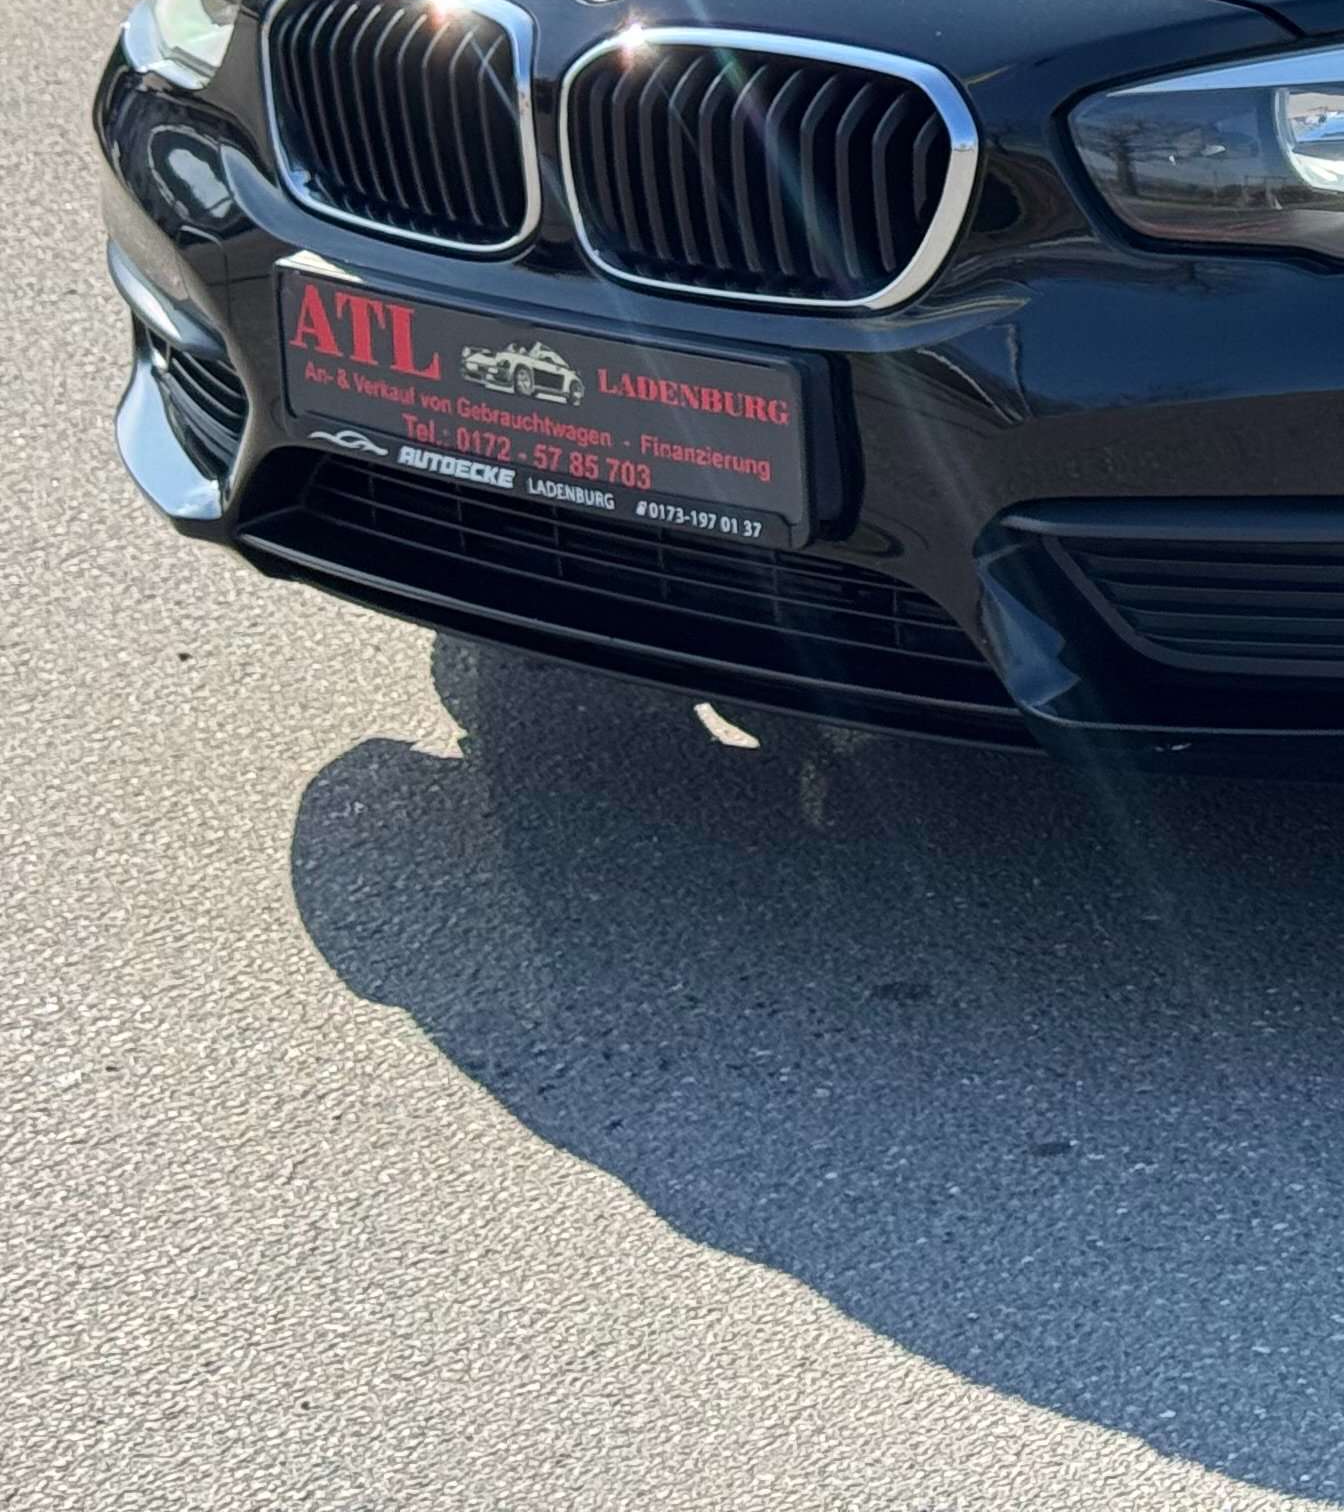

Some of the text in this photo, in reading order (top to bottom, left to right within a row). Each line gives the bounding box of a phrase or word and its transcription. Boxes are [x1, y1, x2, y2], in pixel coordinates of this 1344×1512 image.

[289, 282, 442, 381] ATL
[304, 360, 333, 386] An-
[336, 373, 350, 390] &
[354, 371, 416, 407] Verkauf
[421, 392, 451, 414] von
[457, 397, 612, 448] Gebrauchtwagen
[640, 433, 772, 483] Finanzierung
[597, 367, 791, 426] LADENBURG
[403, 412, 449, 448] Tel.:
[457, 427, 512, 462] 0172
[533, 443, 563, 470] 57
[569, 451, 599, 480] 85
[606, 457, 653, 491] 703
[528, 477, 616, 510] LADENBURG
[649, 505, 717, 529] 0173-197
[720, 516, 739, 535] 01
[742, 519, 762, 539] 37
